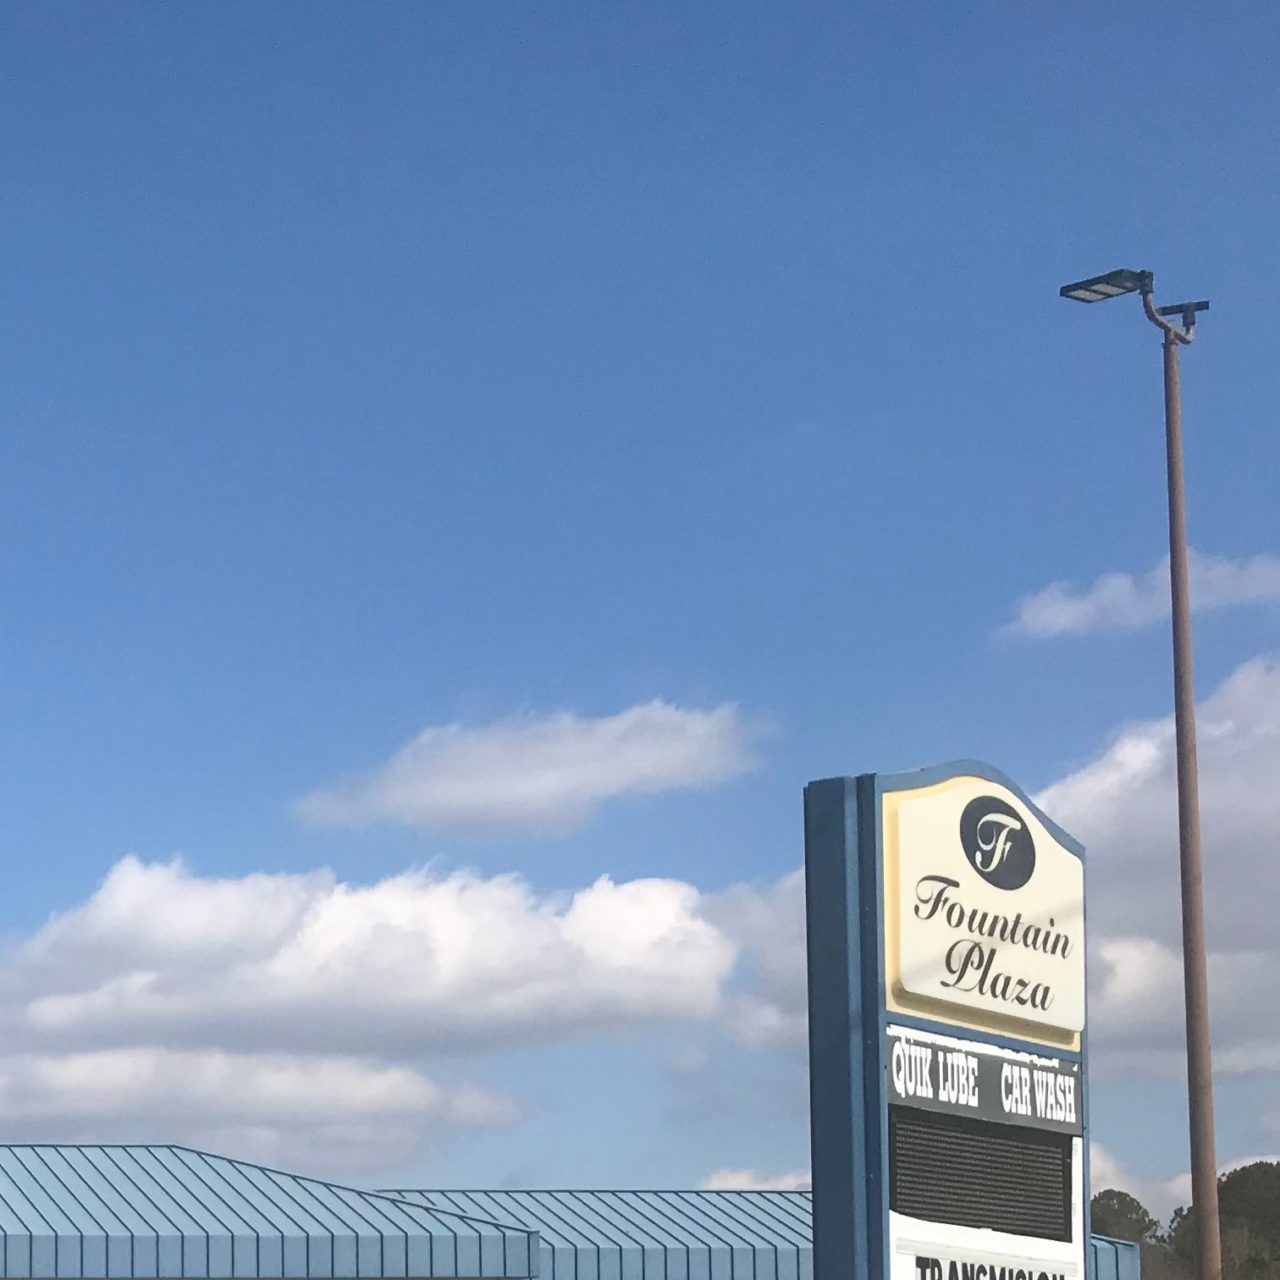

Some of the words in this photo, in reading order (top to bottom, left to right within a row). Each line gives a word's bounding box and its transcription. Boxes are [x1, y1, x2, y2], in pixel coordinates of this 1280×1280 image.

[914, 875, 1073, 959] Fountain
[940, 938, 1054, 1012] Plaza
[892, 1039, 934, 1099] QUIK
[938, 1051, 979, 1107] LUBE
[1001, 1062, 1032, 1118] CAR
[1033, 1068, 1076, 1124] WASH
